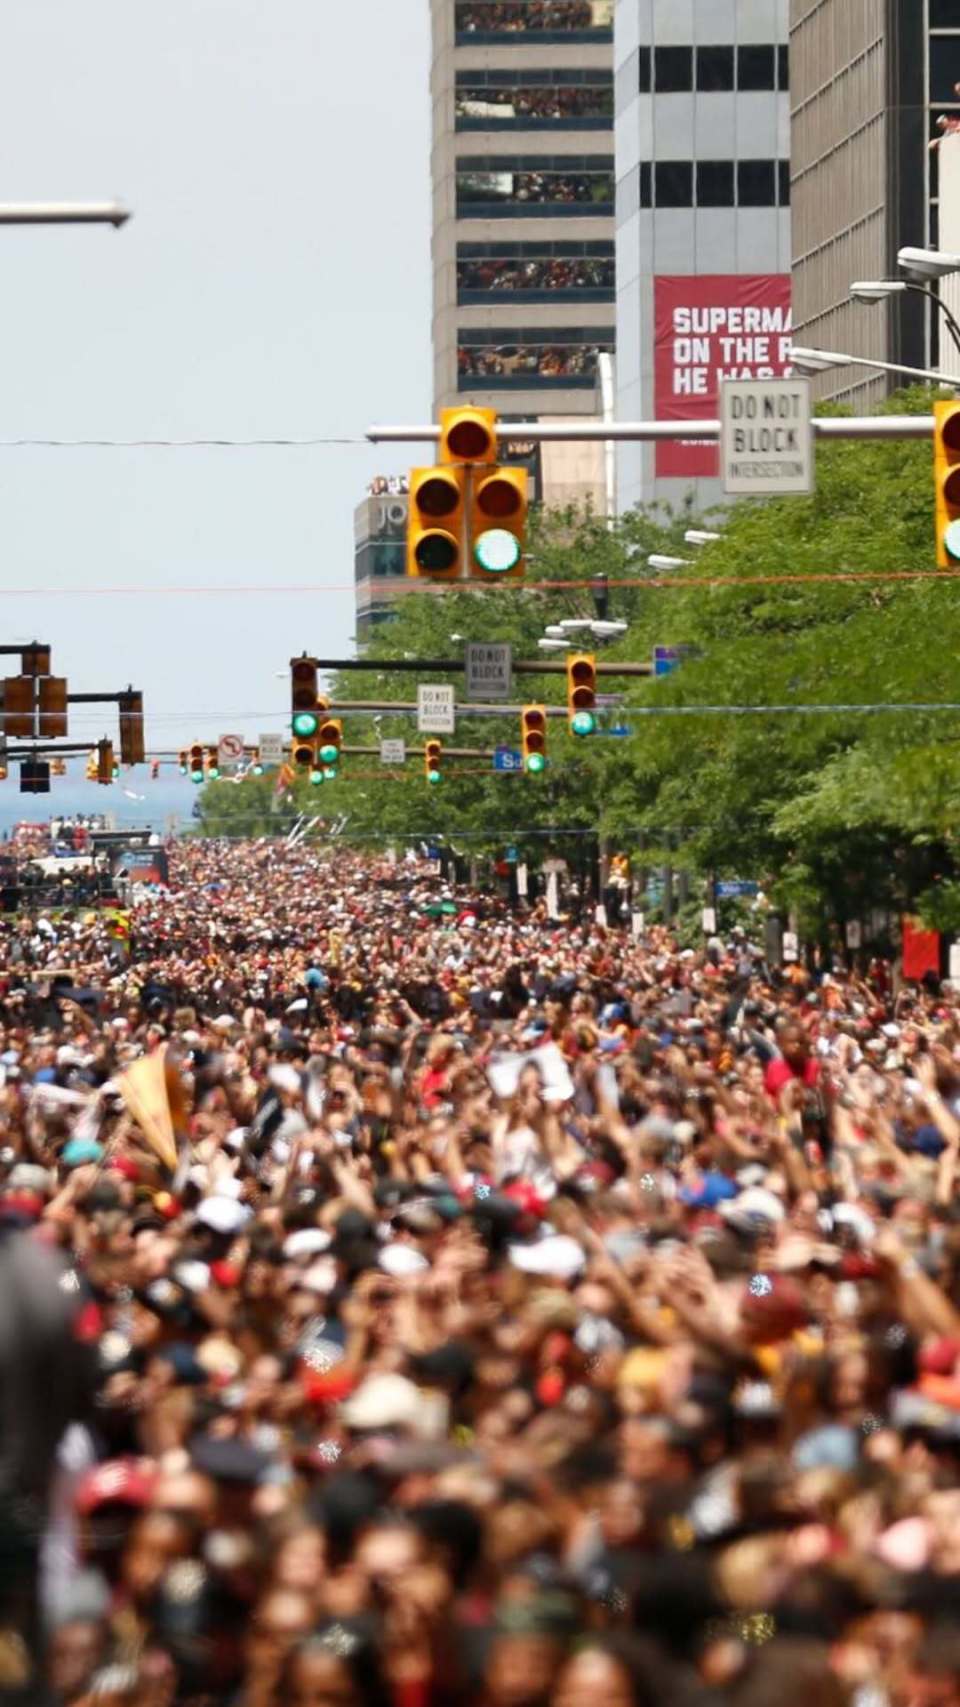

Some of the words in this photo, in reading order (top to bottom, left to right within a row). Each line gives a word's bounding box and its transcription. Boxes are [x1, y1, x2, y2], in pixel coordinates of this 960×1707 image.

[674, 338, 710, 364] ON
[718, 338, 770, 364] THE
[674, 367, 708, 394] HE
[731, 394, 758, 419] DO
[763, 394, 800, 419] NOT
[733, 427, 800, 452] BLOCK
[471, 648, 485, 662] DO
[486, 648, 506, 662] NOT
[471, 664, 505, 679] BLOCK
[423, 703, 448, 716] BLOCK
